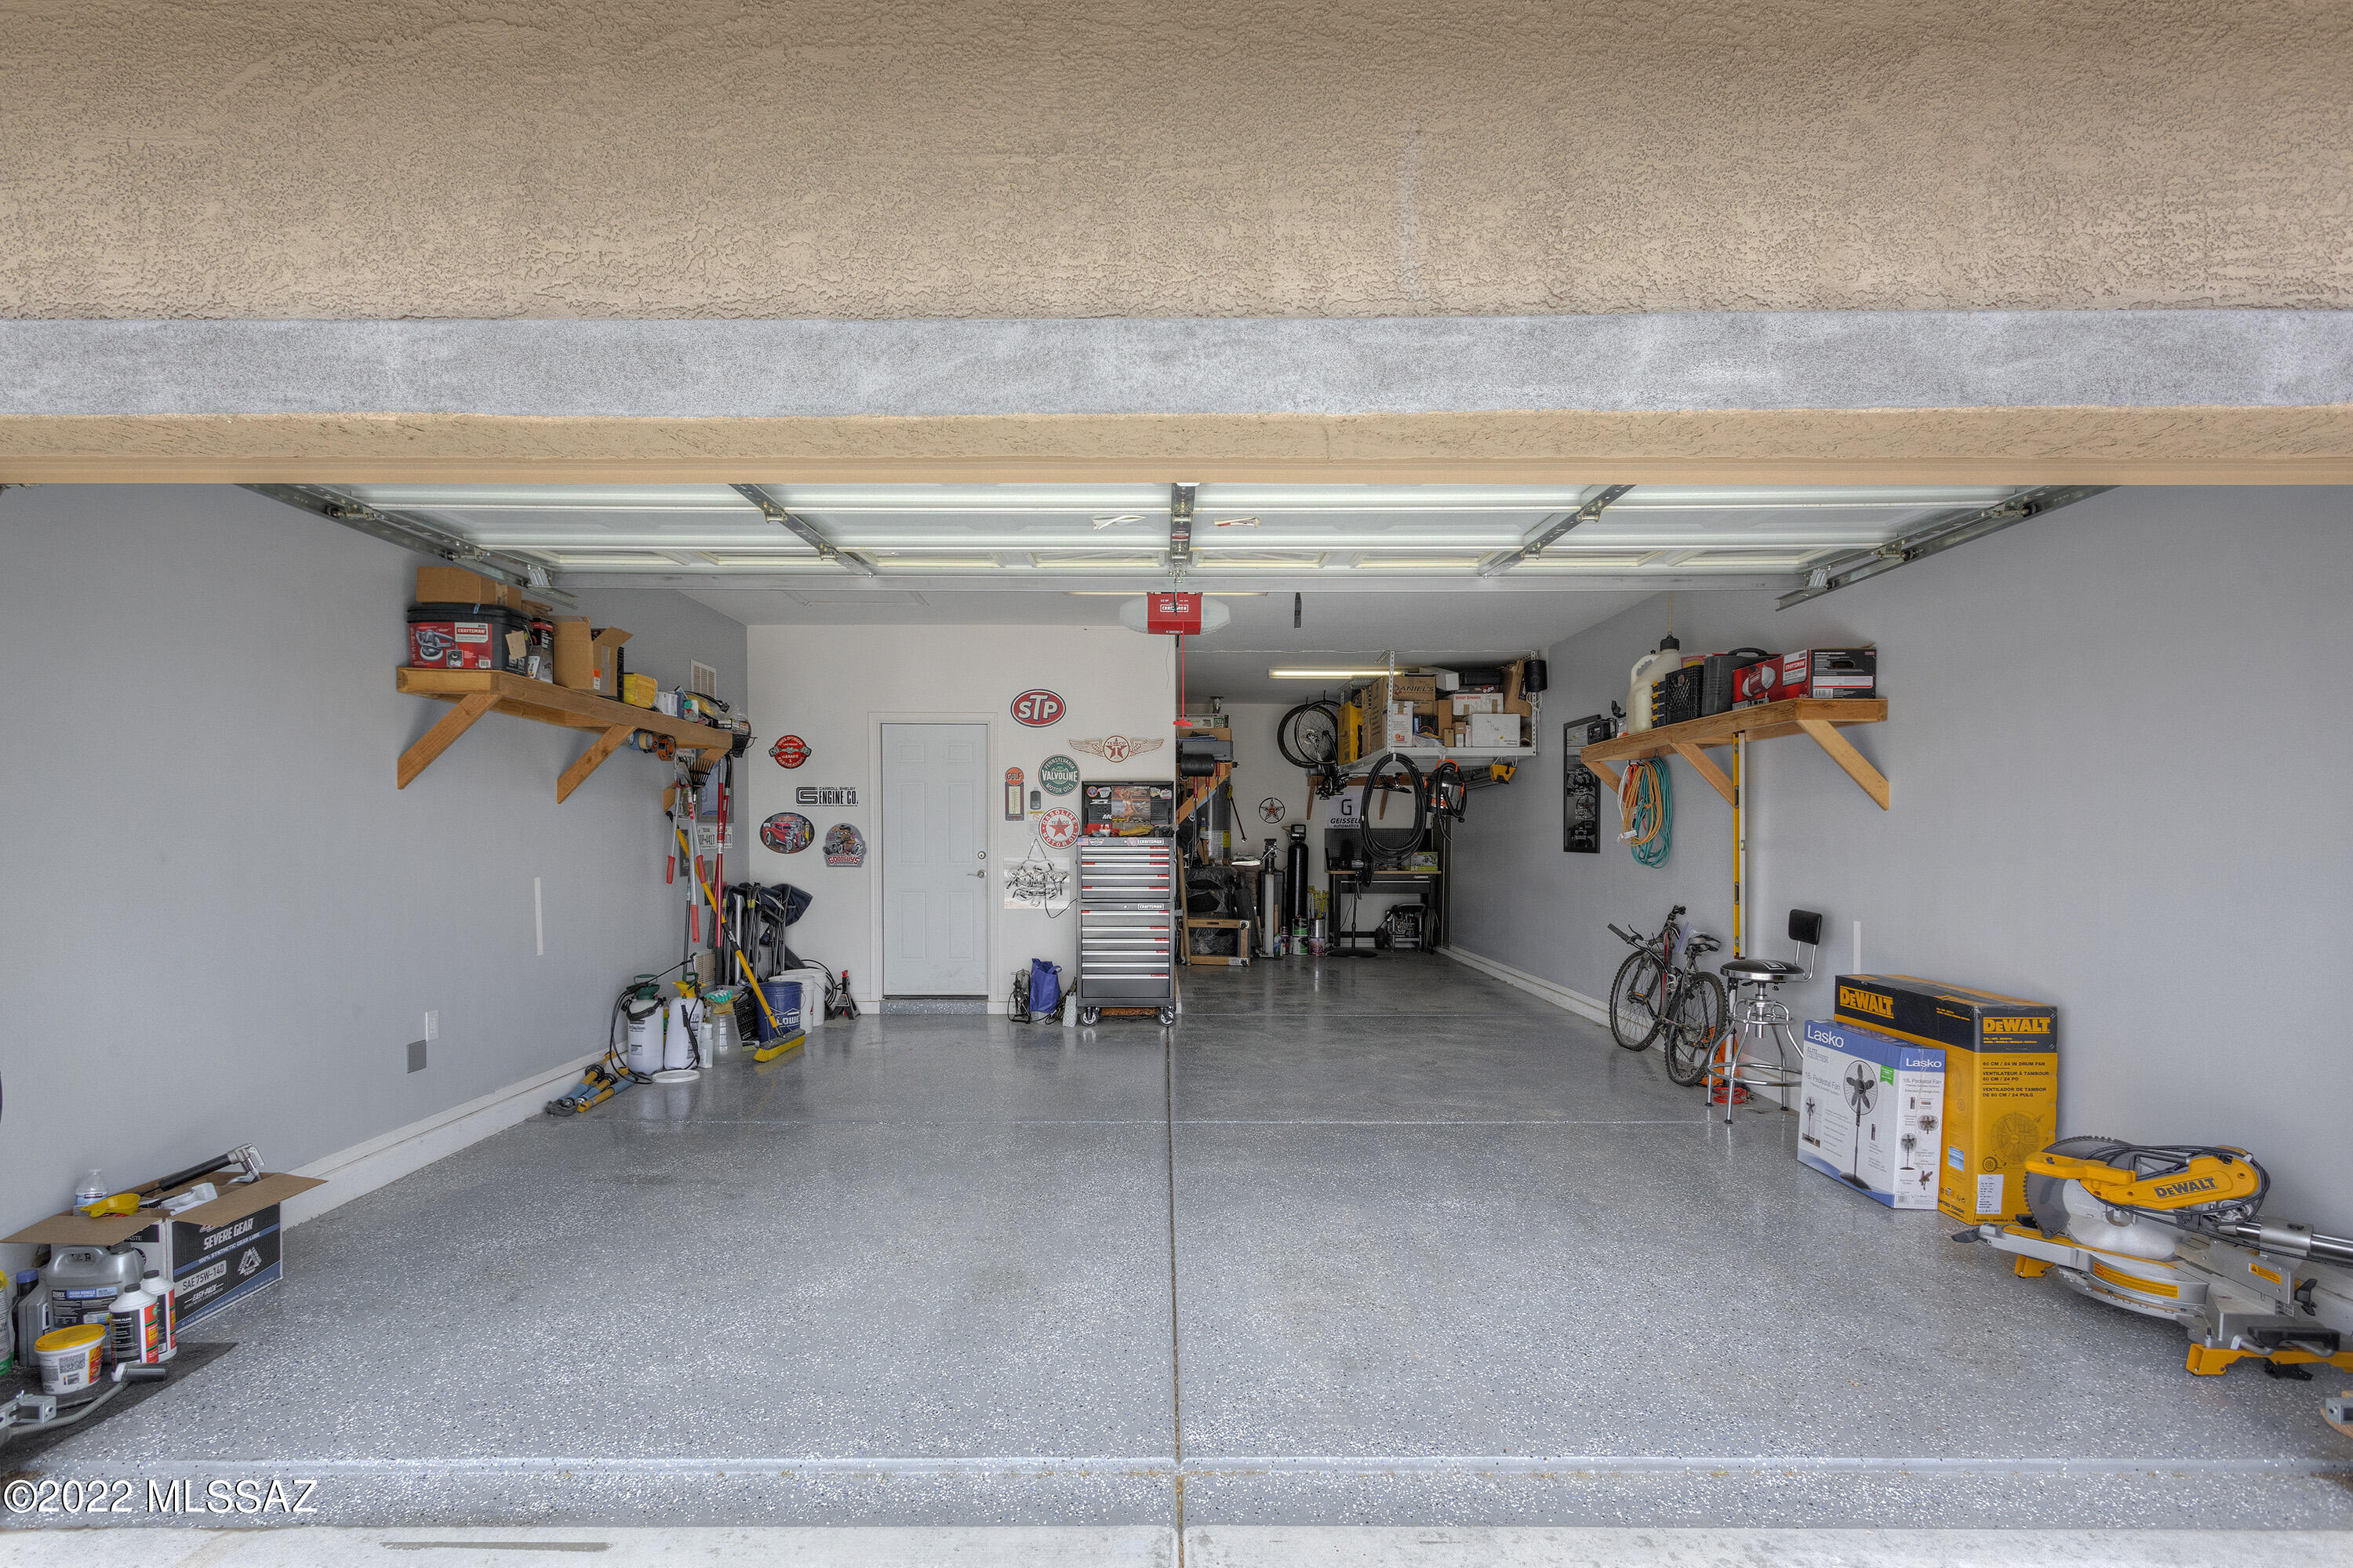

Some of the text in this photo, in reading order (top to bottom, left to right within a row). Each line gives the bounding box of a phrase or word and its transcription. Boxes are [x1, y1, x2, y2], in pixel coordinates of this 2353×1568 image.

[1784, 660, 1806, 671] CRAFTSMAN
[1018, 694, 1059, 721] STP
[1044, 758, 1075, 769] PENNSYLVANIA
[1006, 772, 1022, 780] GULF
[1042, 769, 1078, 782] VALVOLINE
[1046, 782, 1074, 793] MOTOR OILS
[819, 791, 859, 804] ENGINE CO.
[1341, 799, 1351, 816] G
[1042, 809, 1078, 825] GASOLINE
[1042, 831, 1078, 847] MOTOR OIL
[827, 856, 861, 864] GOODGUYS
[1839, 988, 1894, 1017] DEWALT
[1983, 1019, 2051, 1031] DEWALT
[1807, 1024, 1845, 1048] Lasko
[1906, 1058, 1942, 1068] Lasko
[1813, 1074, 1831, 1087] Pedestal
[1831, 1081, 1841, 1090] Fan
[2154, 1178, 2216, 1197] DEWALT
[203, 1217, 255, 1251] SEVERE GEAR
[198, 1232, 260, 1264] 100% SYNTHETIC GEAR LUBE
[183, 1264, 224, 1291] SAE 75W-140
[192, 1284, 217, 1301] EASY-PACK
